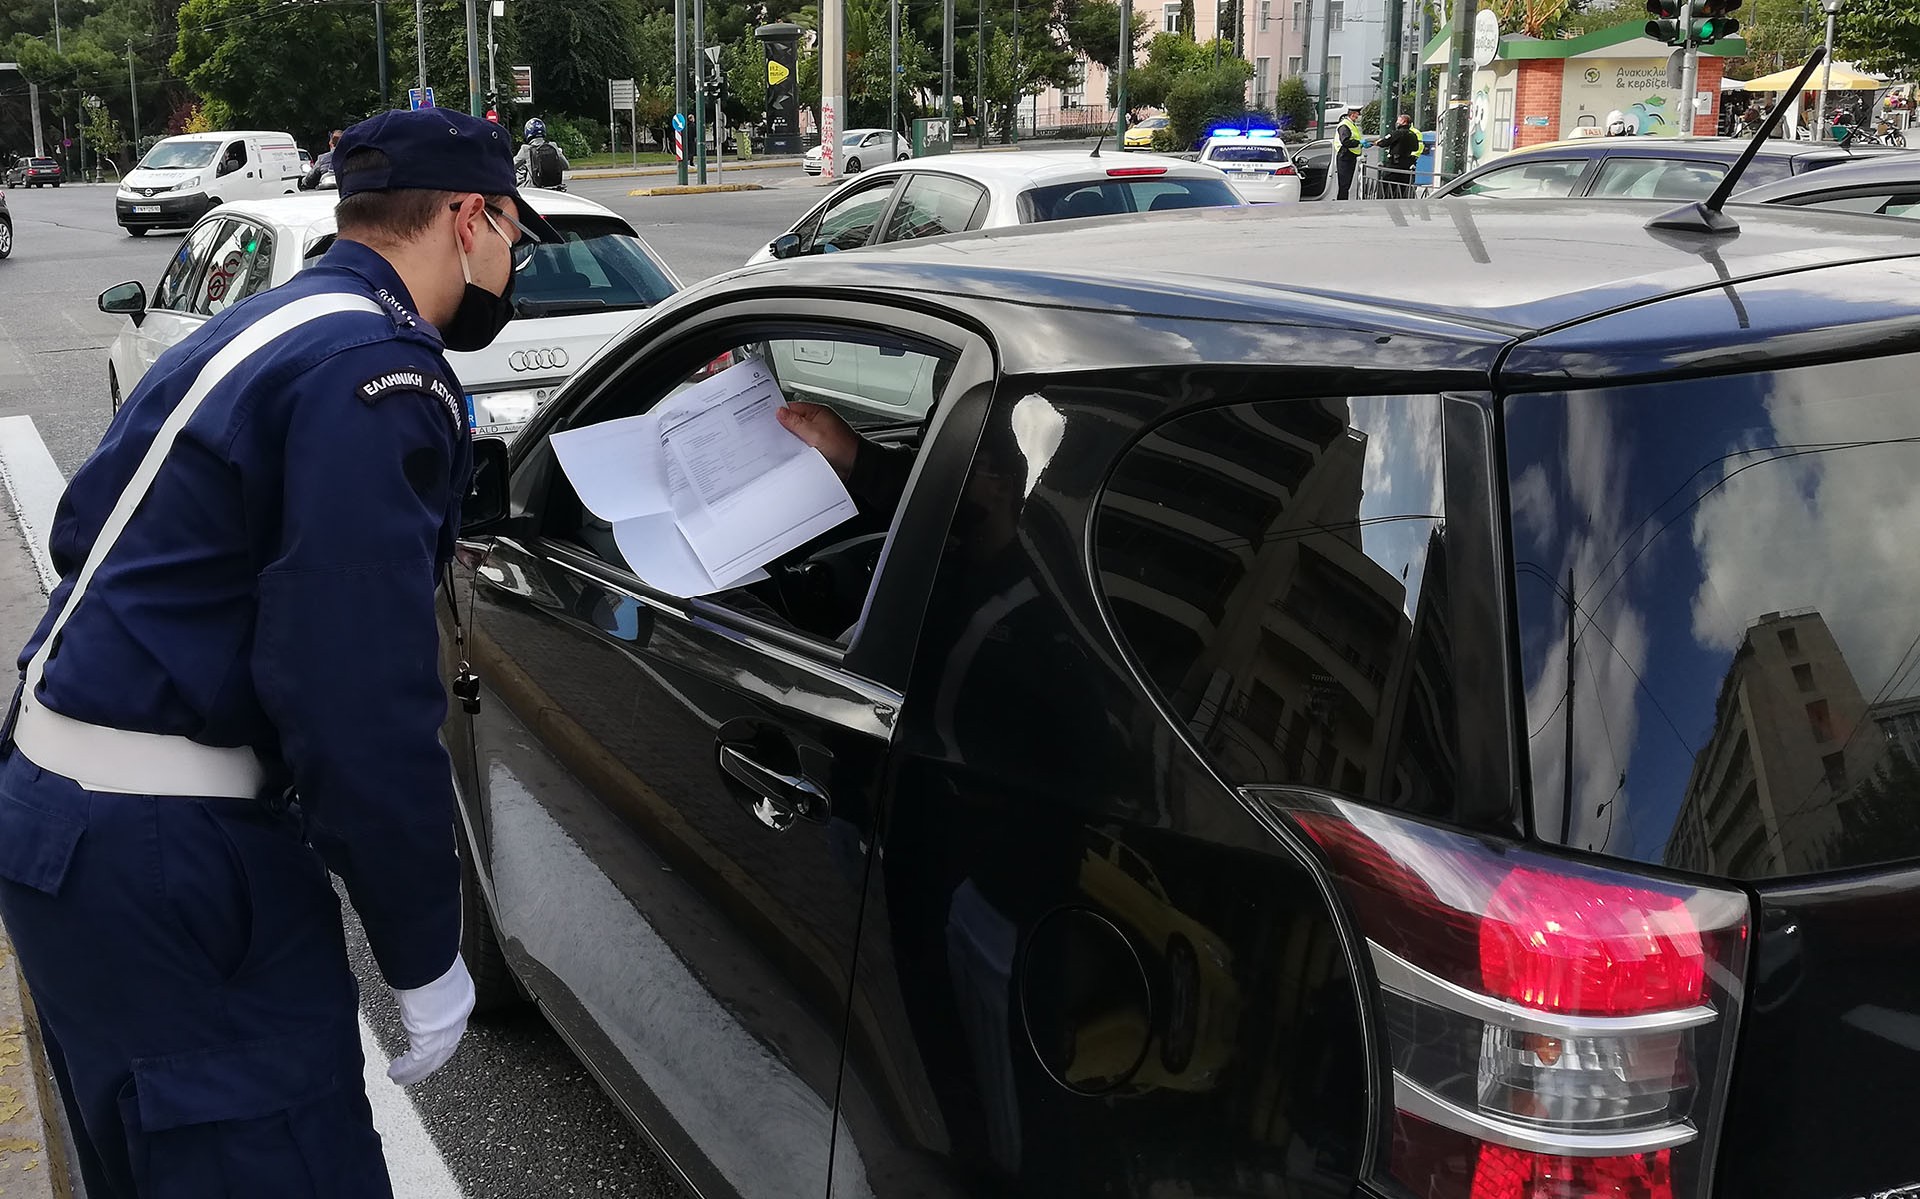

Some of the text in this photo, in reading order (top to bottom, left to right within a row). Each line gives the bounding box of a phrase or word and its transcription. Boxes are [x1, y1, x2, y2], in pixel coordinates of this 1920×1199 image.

[1616, 66, 1667, 77] Ανακυκλώ
[1616, 77, 1670, 91] & κερδίζει
[363, 372, 461, 431] ΕΛΛΗΝΙΚΗ ΑΣΤΥΝΟΜΙΑ
